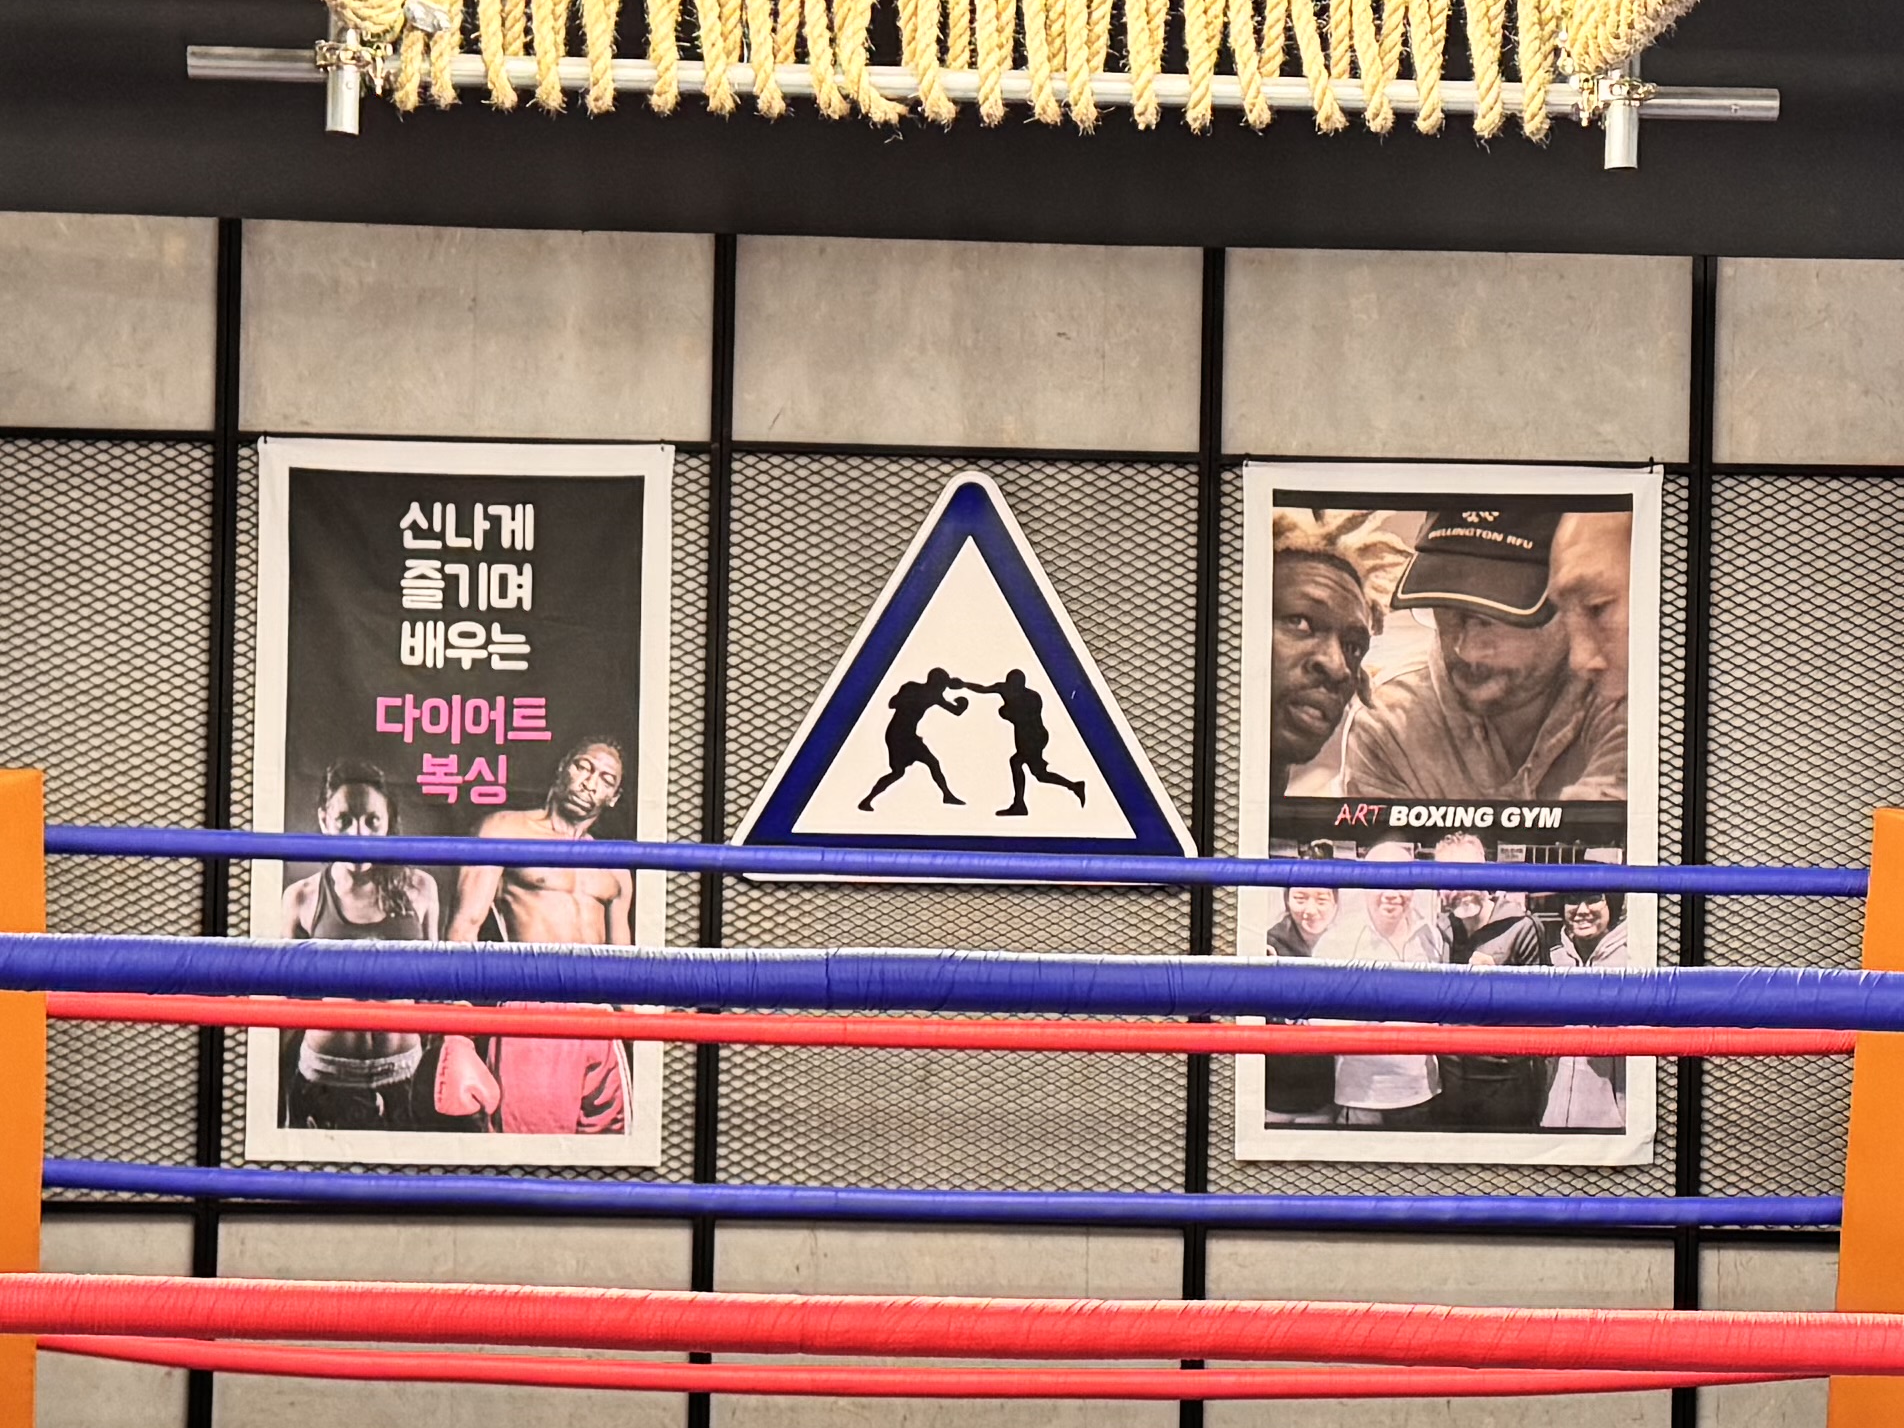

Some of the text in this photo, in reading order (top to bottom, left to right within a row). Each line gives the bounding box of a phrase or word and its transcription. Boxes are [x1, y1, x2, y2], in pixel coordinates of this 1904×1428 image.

[399, 500, 535, 553] 신나게
[1507, 535, 1534, 550] RFU
[399, 558, 533, 612] 즐기며
[400, 620, 532, 671] 배우는
[375, 693, 553, 745] 다이어트
[416, 753, 508, 805] 복싱
[1334, 803, 1563, 829] ART BOXING GYM
